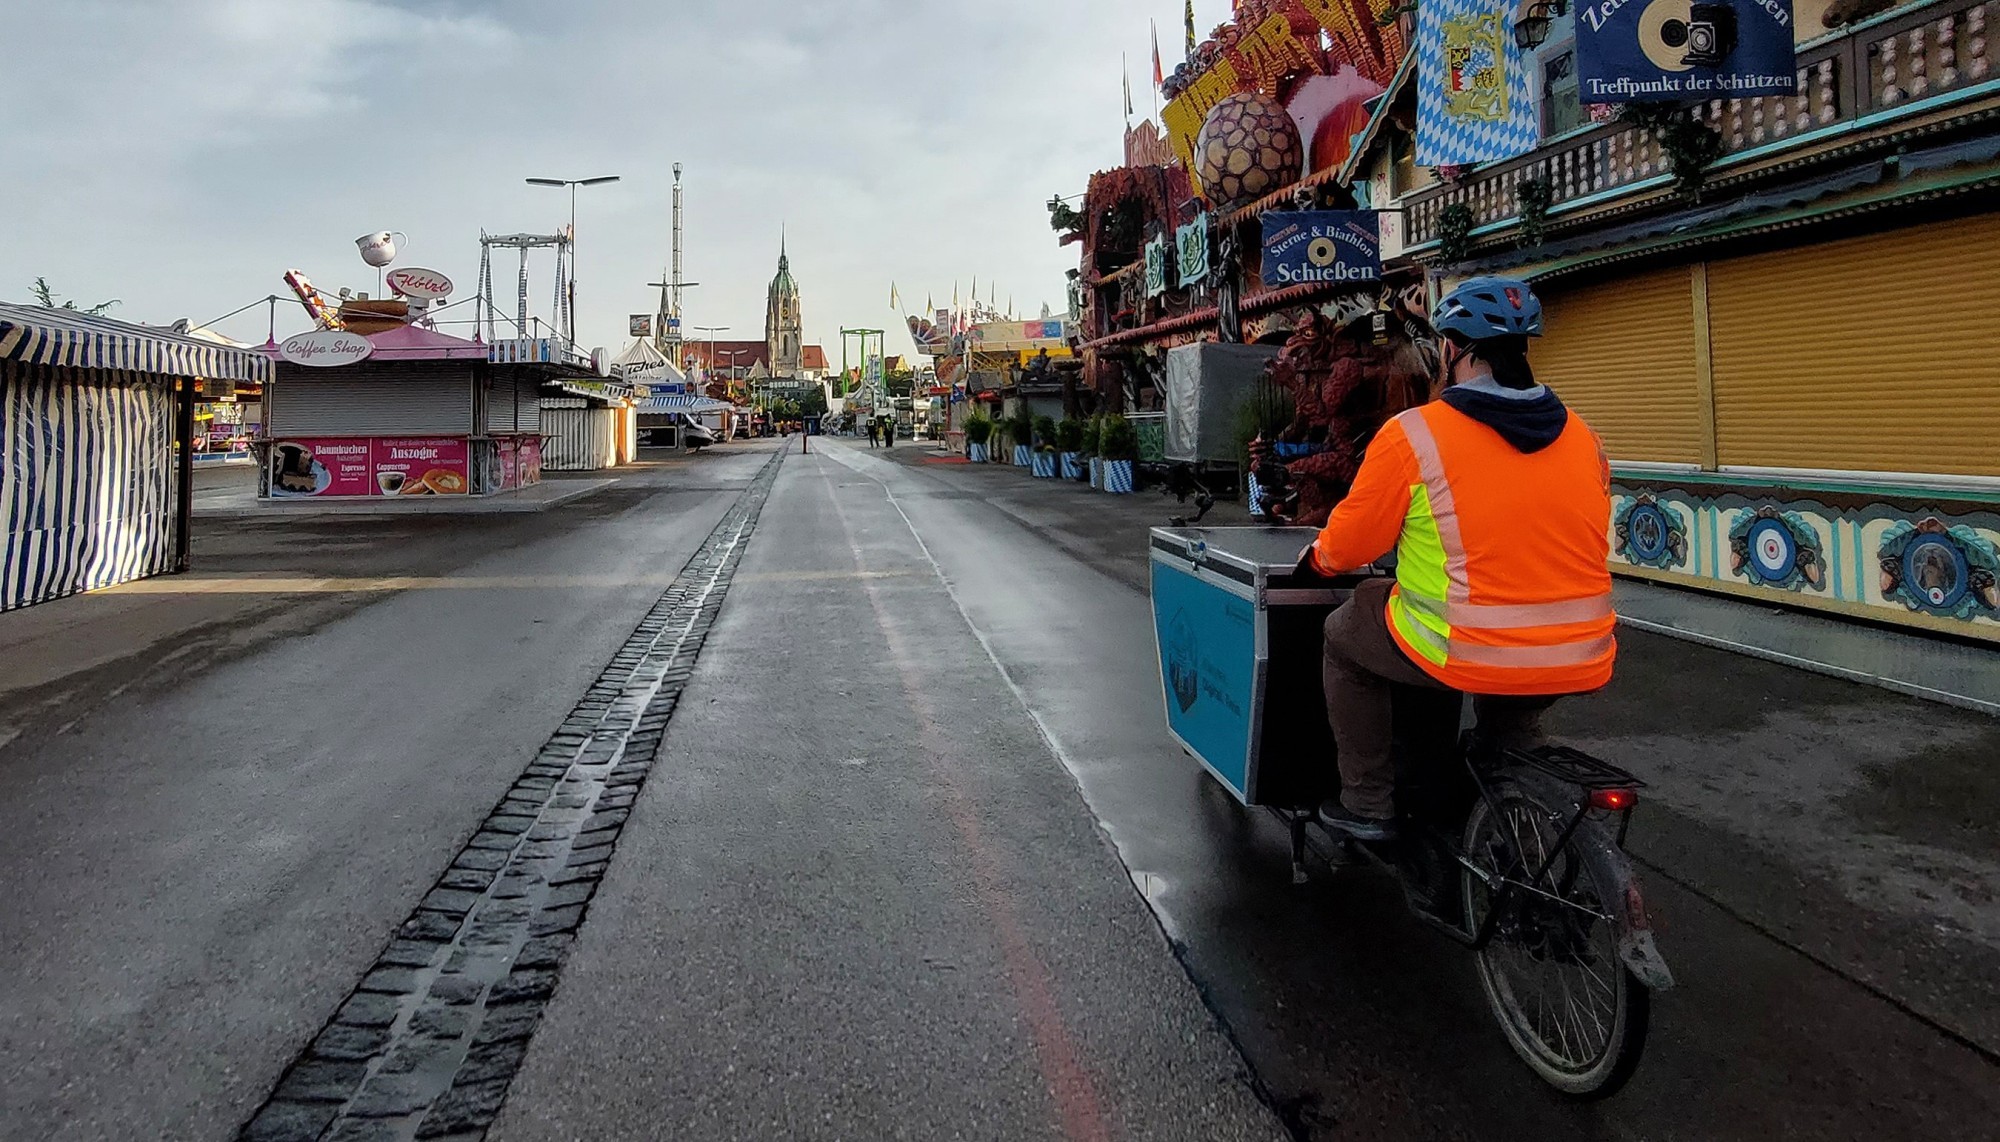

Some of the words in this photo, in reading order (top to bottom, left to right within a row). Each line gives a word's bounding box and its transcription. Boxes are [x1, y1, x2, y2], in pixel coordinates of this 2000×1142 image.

[1586, 76, 1680, 97] Treffpunkt
[1685, 75, 1712, 90] der
[1716, 73, 1792, 90] Schützen
[1271, 231, 1307, 258] Sterne
[1311, 225, 1322, 237] &
[1326, 225, 1374, 258] Biathlon
[1277, 260, 1374, 282] Schießen
[286, 341, 326, 358] Coffee
[331, 340, 366, 358] Shop
[315, 445, 368, 455] Baumkuchen
[391, 447, 438, 460] Auszogne
[341, 464, 366, 472] Espresso
[376, 463, 410, 471] Cappuccino
